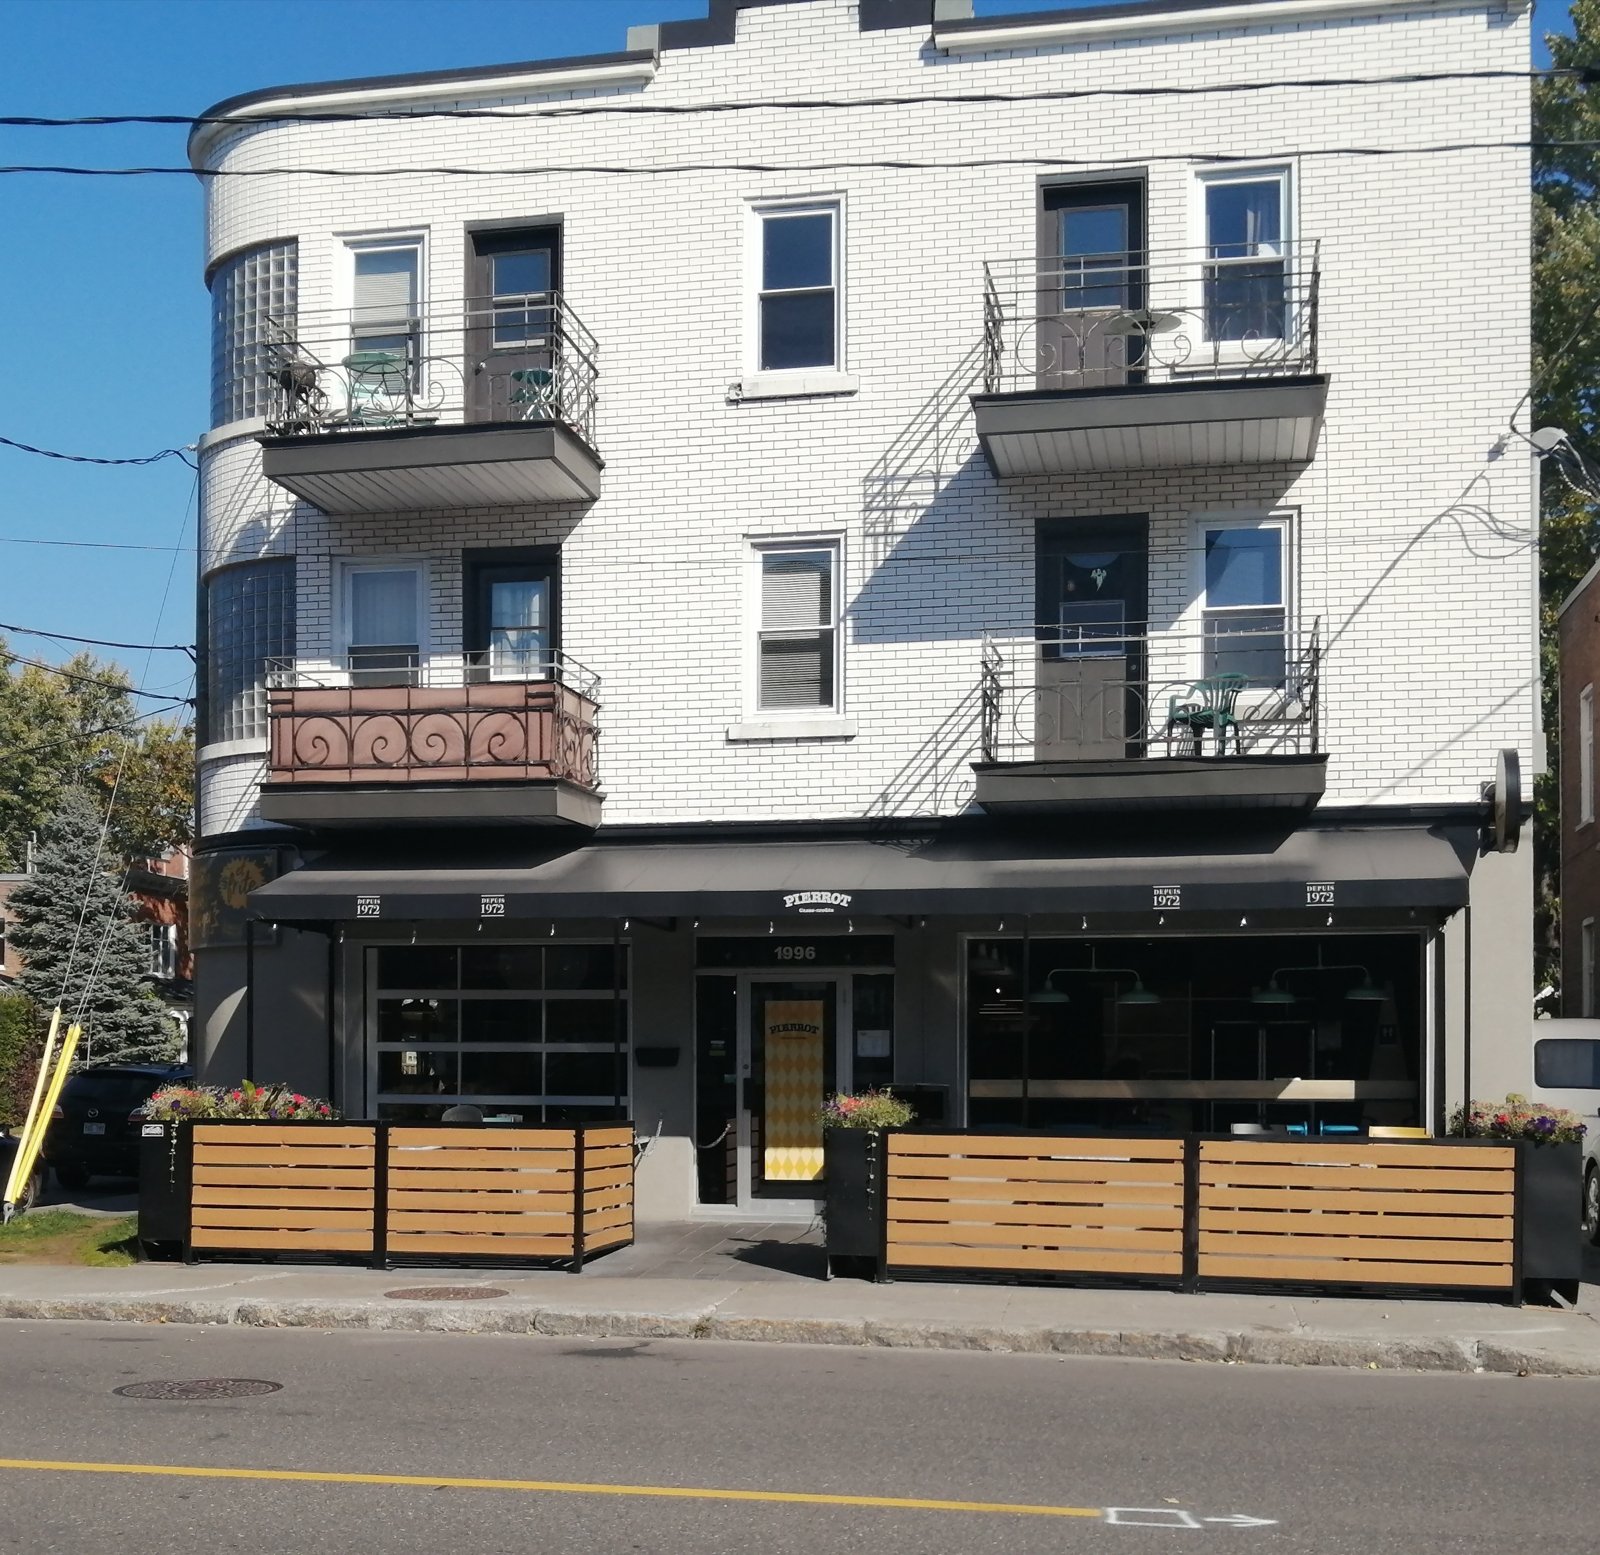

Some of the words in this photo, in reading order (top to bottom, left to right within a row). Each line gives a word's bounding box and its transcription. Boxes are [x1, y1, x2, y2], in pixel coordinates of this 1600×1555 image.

[783, 892, 852, 908] PIERROT
[1153, 896, 1181, 906] 1972
[1306, 892, 1335, 903] 1972
[357, 905, 380, 915] 1972
[481, 904, 505, 914] 1972
[774, 946, 816, 960] 1996
[769, 1023, 820, 1035] PIERROT
